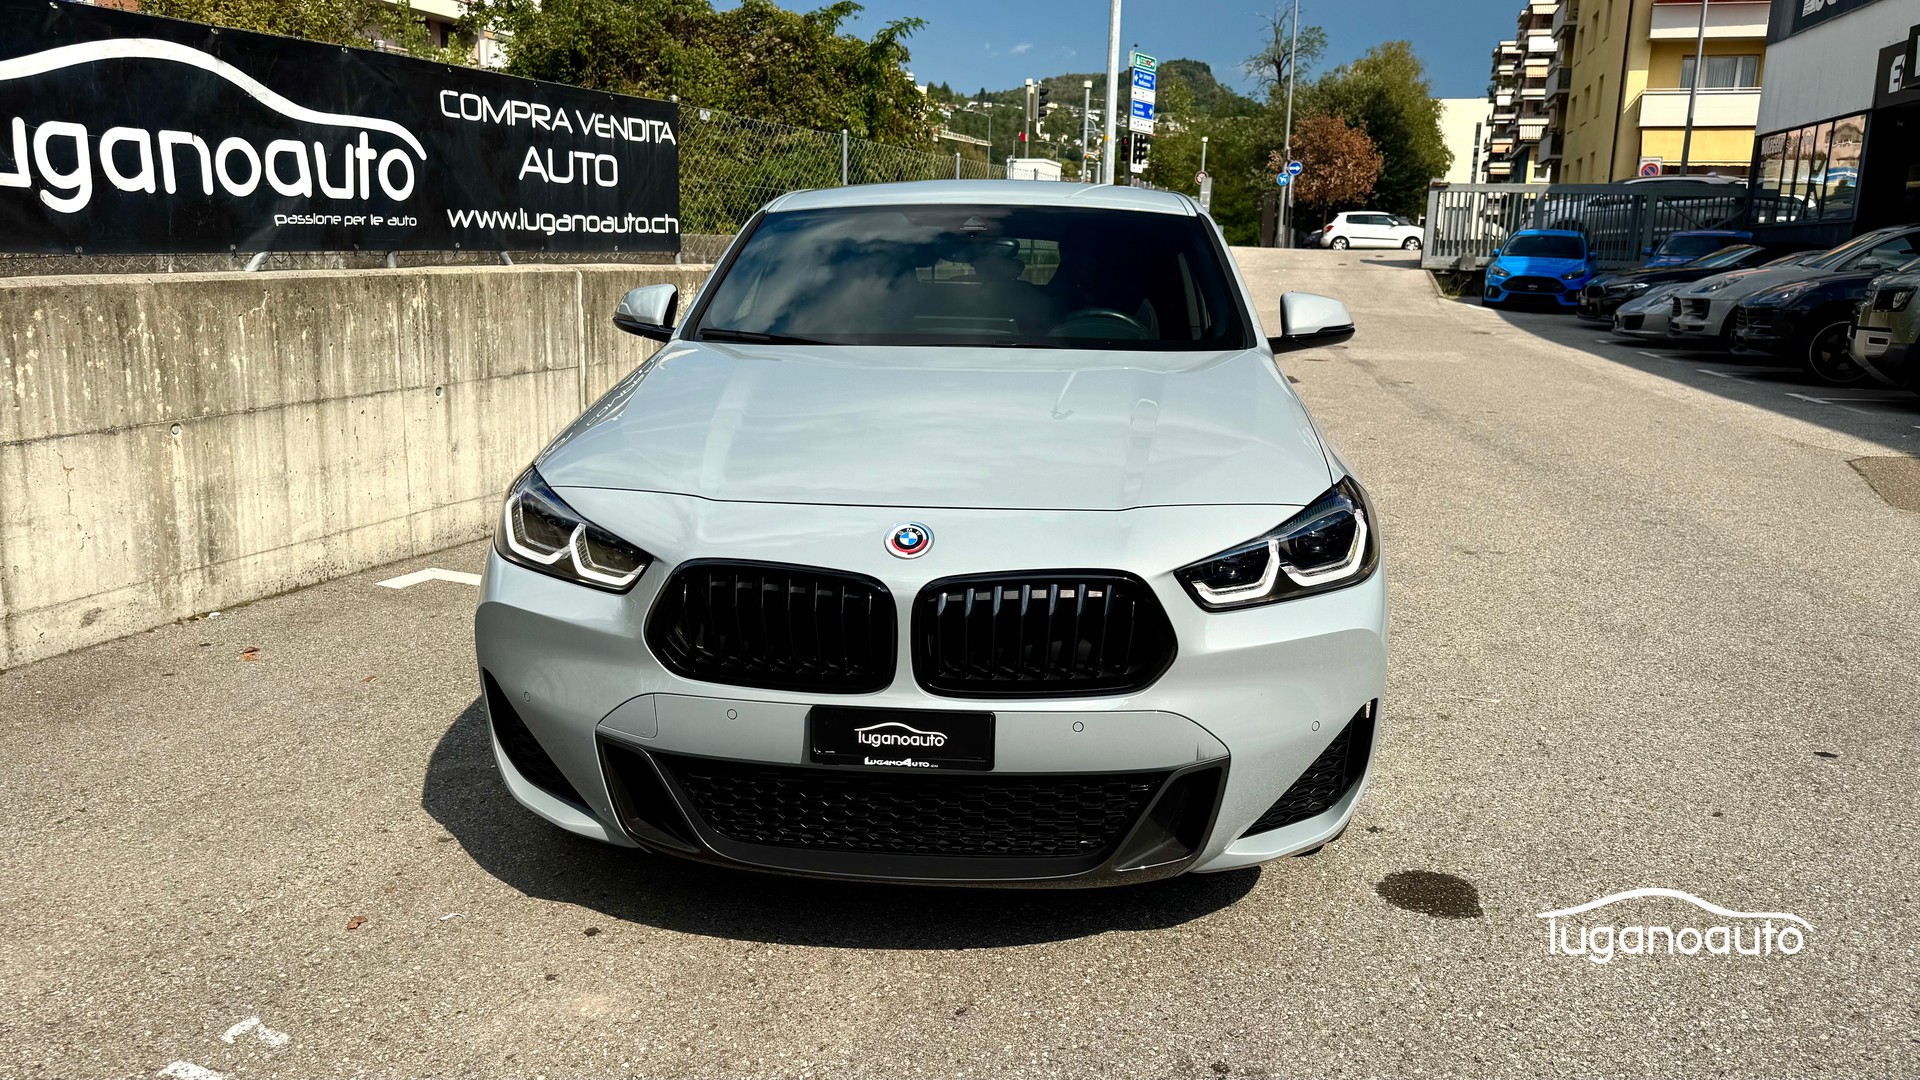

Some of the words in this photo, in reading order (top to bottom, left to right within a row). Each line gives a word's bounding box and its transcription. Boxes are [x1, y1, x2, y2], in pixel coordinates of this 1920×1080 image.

[439, 89, 574, 134] COMPRA
[575, 109, 677, 146] VENDITA
[518, 145, 619, 187] AUTO
[274, 212, 342, 227] passione
[344, 214, 367, 227] per
[370, 213, 384, 226] le
[387, 215, 418, 227] auto
[446, 207, 679, 236] www.luganoauto.ch
[858, 730, 945, 748] luganoauto
